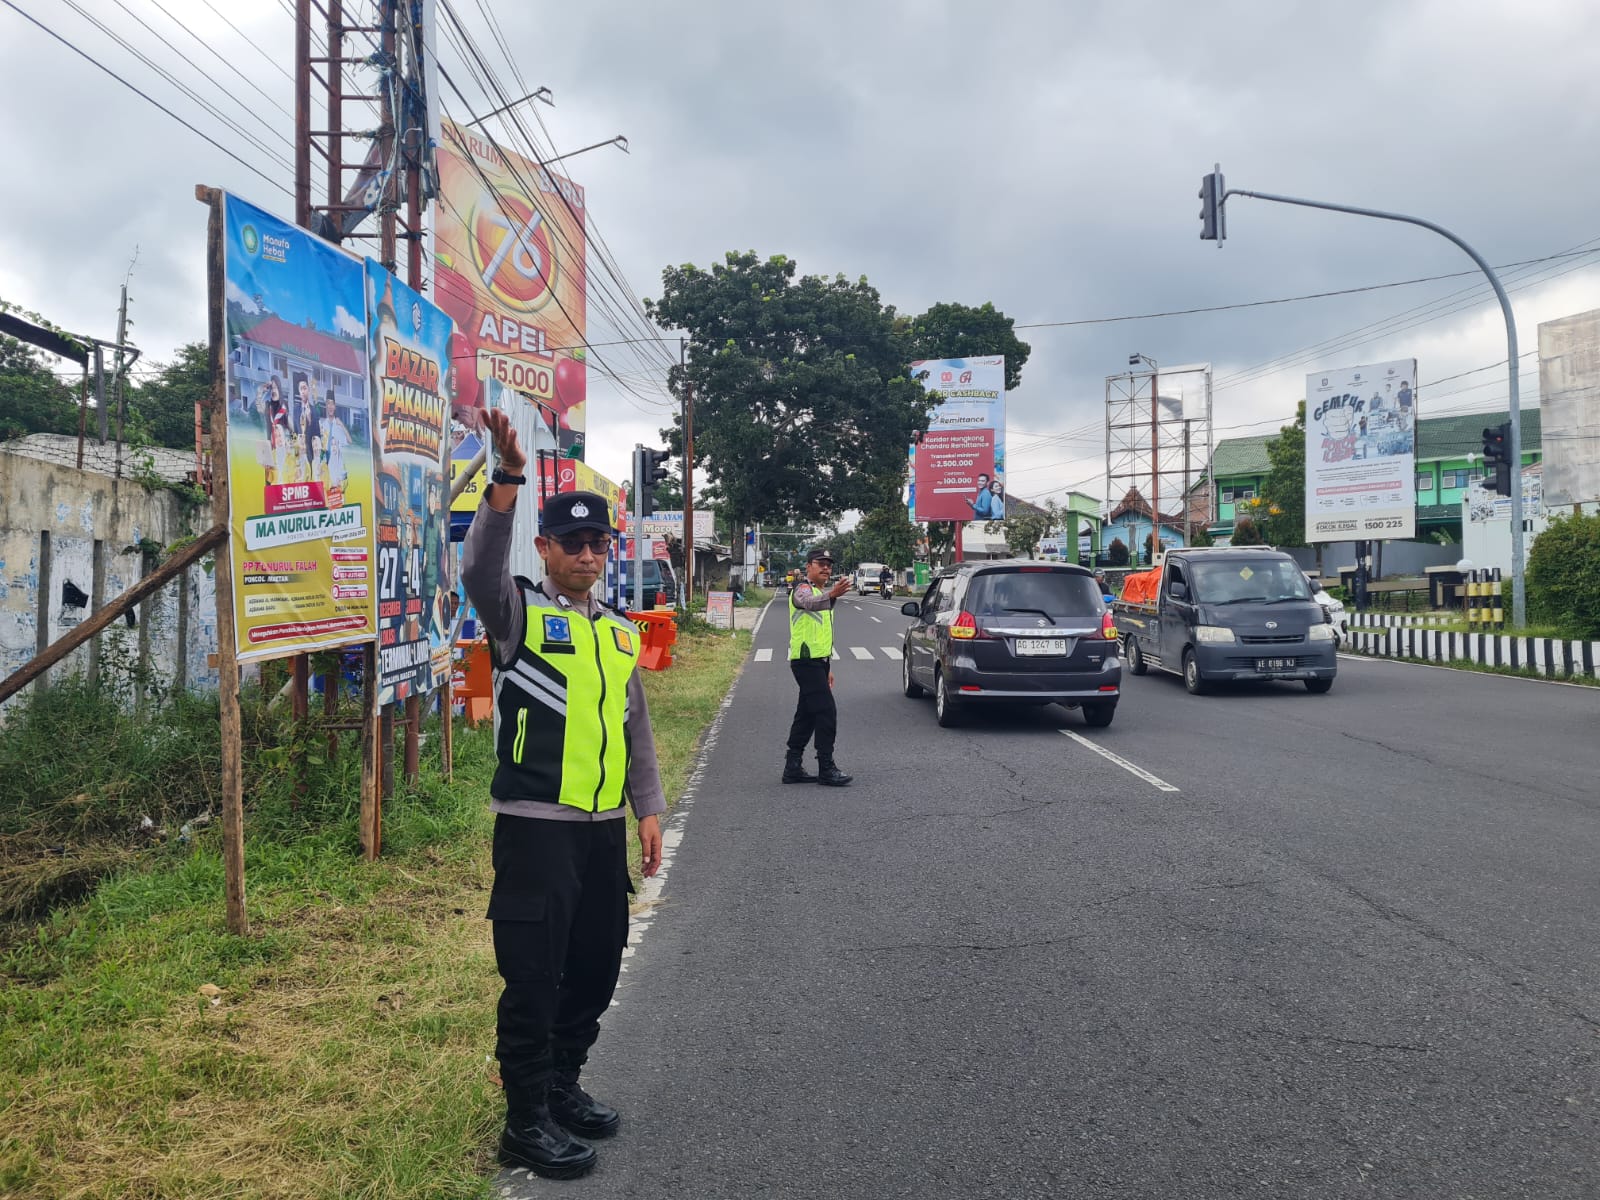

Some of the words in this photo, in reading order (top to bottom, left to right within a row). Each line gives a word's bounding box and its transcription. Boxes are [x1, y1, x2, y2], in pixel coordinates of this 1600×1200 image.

[440, 123, 503, 168] DJARUM
[478, 313, 553, 359] APEL
[386, 339, 439, 393] BAZAR
[490, 357, 549, 394] 15.000
[383, 378, 444, 428] PAKAIAN
[950, 389, 999, 400] CASHBACK
[1313, 393, 1366, 421] GEMPUR
[387, 416, 415, 441] AKHIR
[941, 416, 985, 424] Remittance
[415, 423, 440, 452] TAHUN
[281, 485, 309, 502] SPMB
[943, 477, 972, 485] 100.000
[255, 521, 276, 539] MA
[278, 515, 317, 535] NURUL
[318, 510, 354, 528] FALAH
[1364, 521, 1384, 530] 1500
[1386, 521, 1403, 529] 225
[295, 560, 317, 572] FALAH
[380, 547, 398, 600] 27
[411, 548, 420, 597] 4
[380, 643, 413, 674] TERMINAL
[1017, 640, 1027, 649] AG
[1030, 640, 1050, 649] 1247
